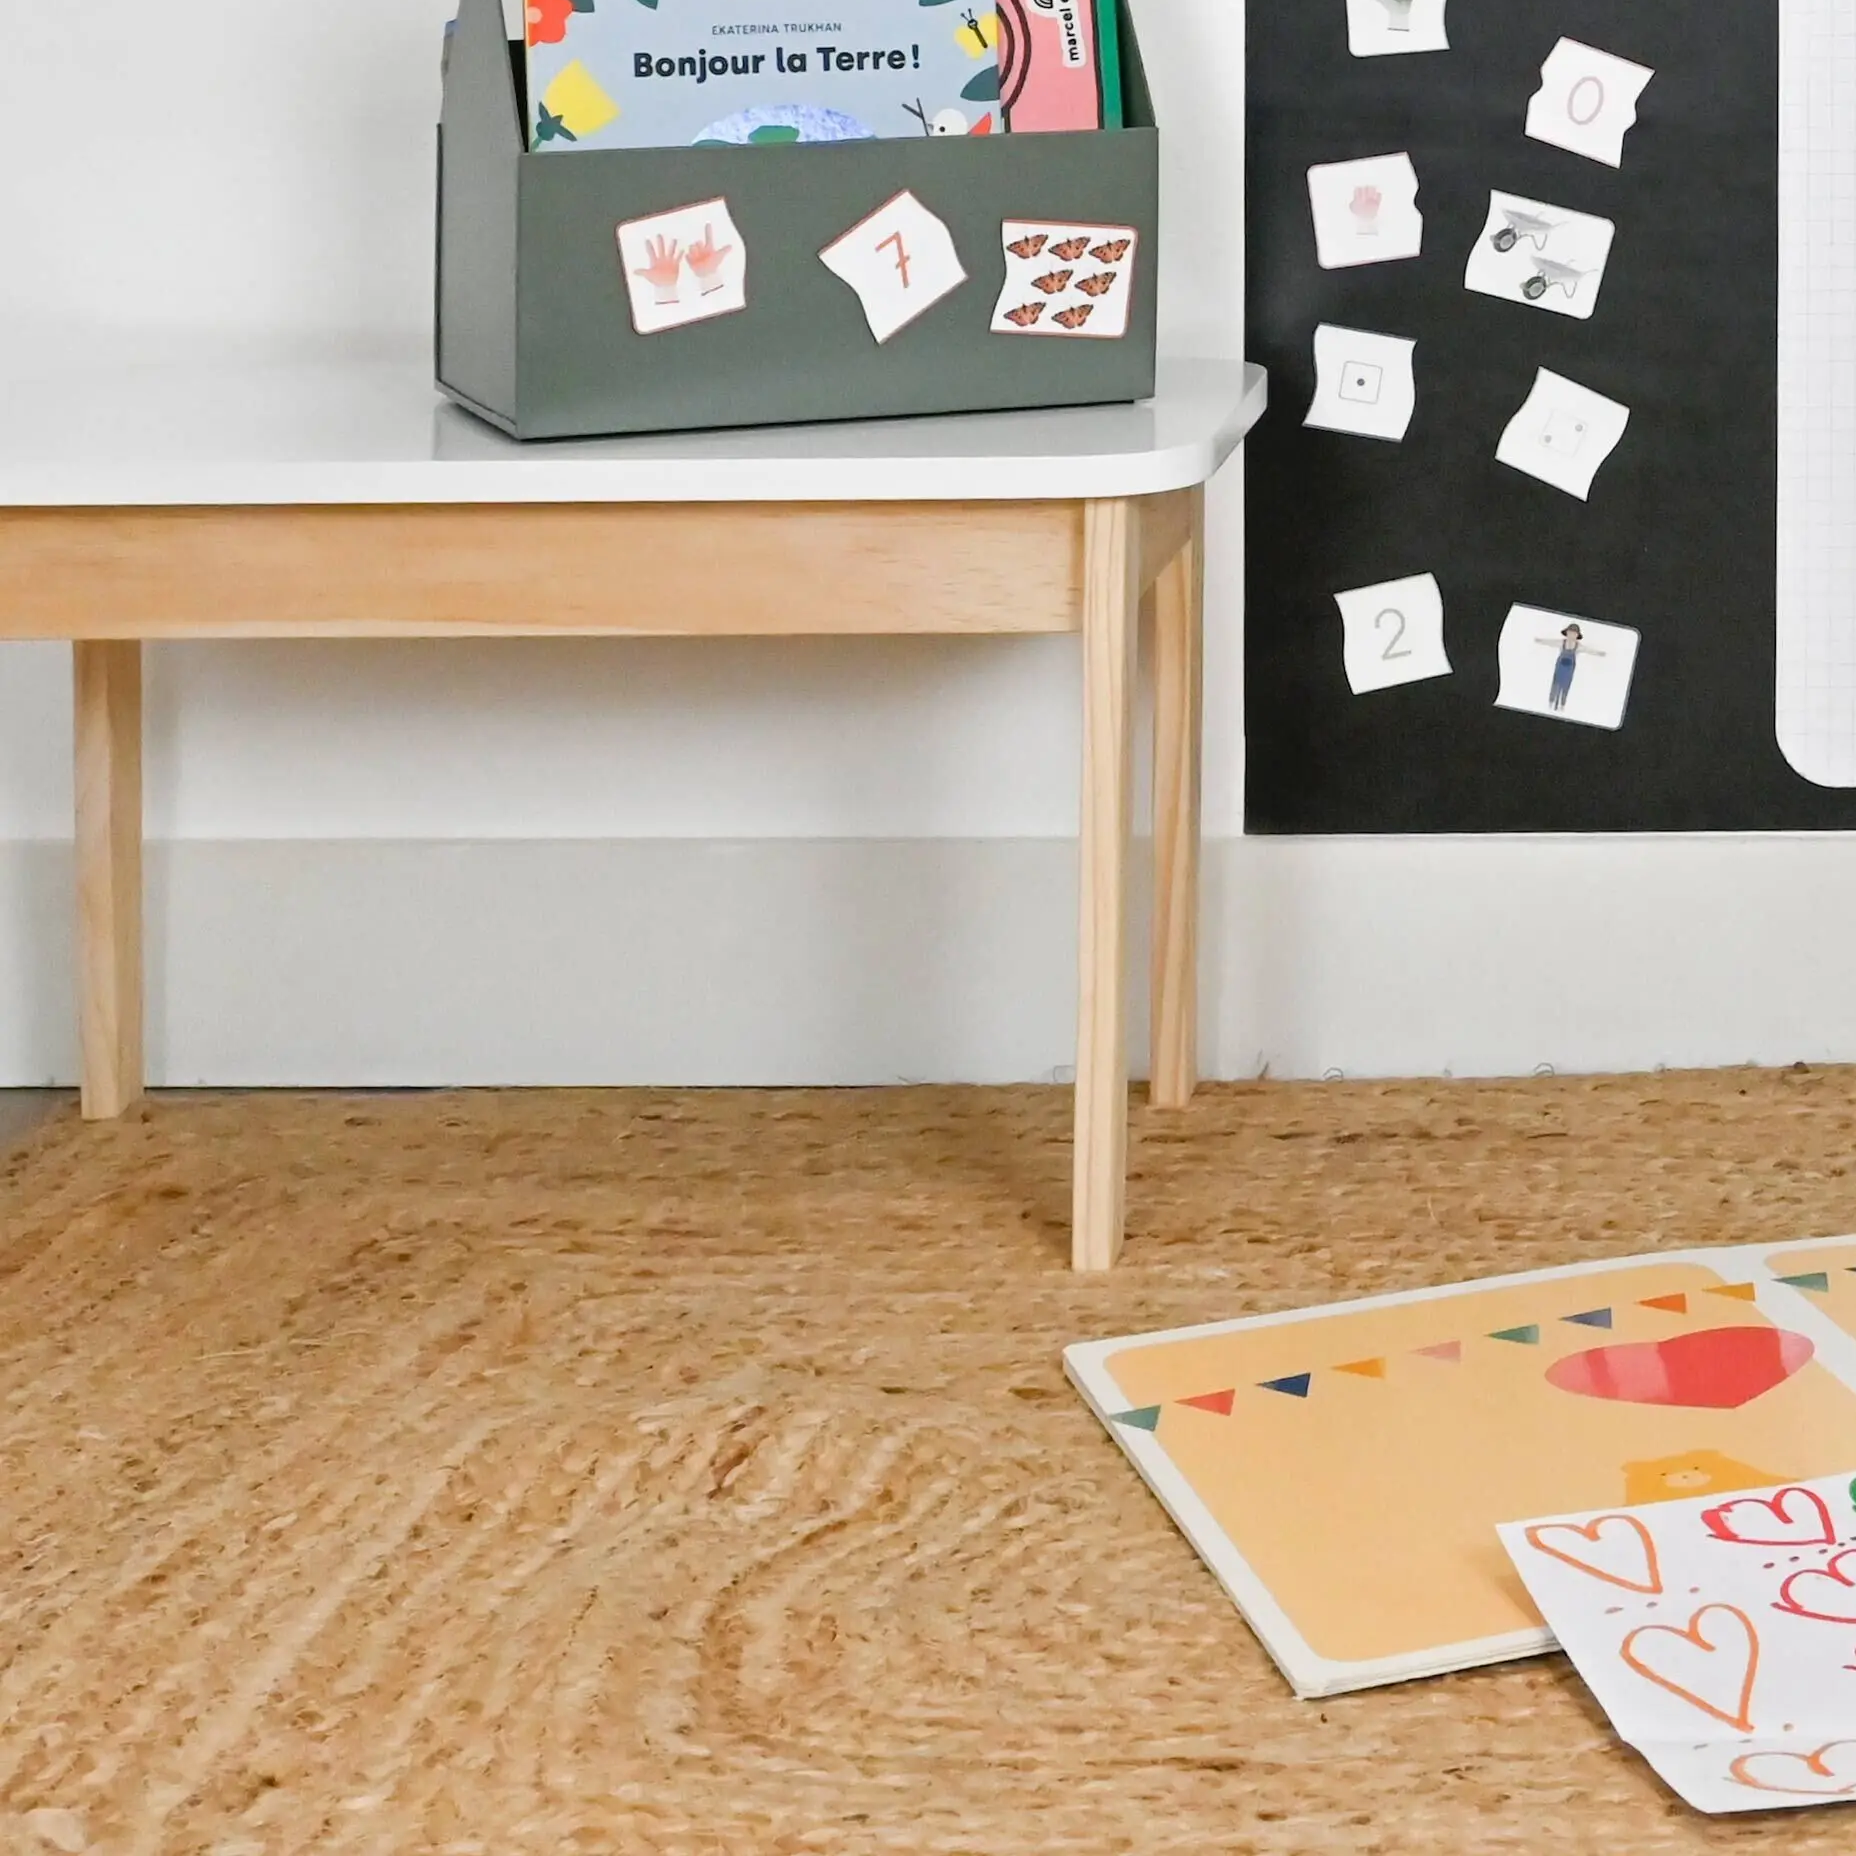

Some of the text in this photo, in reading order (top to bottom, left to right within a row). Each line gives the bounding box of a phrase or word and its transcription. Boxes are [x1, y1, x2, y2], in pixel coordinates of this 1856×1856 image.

[711, 22, 842, 36] EKATERINA TRUKHAN
[1058, 6, 1080, 61] marcel
[633, 49, 766, 84] Bonjour
[775, 46, 808, 73] la
[875, 231, 911, 289] 7
[1374, 607, 1412, 661] 2
